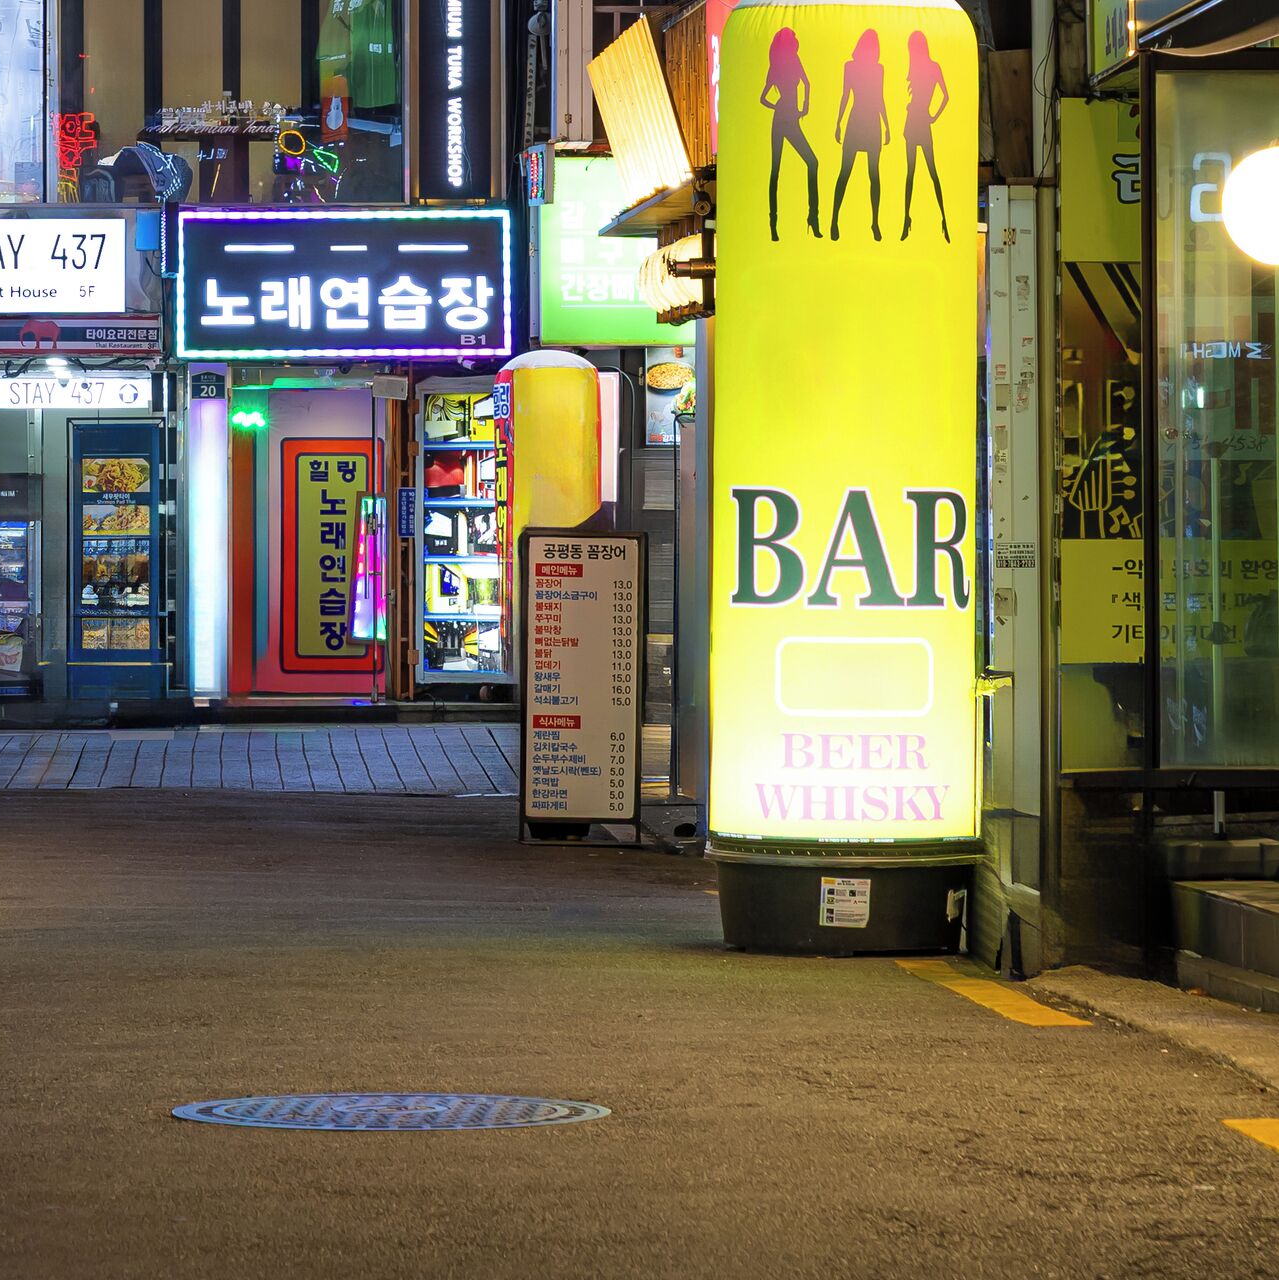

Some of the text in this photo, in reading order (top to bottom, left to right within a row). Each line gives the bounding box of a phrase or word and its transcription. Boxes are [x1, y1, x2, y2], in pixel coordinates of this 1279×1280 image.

[447, 45, 463, 90] TUNA
[447, 96, 463, 188] WORKSHOP
[50, 234, 107, 271] 437
[9, 284, 58, 300] House
[79, 285, 96, 299] 5F
[200, 274, 494, 332] 노래연습장
[85, 328, 158, 340] 타이요리전문점
[460, 333, 488, 346] B1
[9, 381, 105, 405] STAY 437
[200, 385, 217, 398] 20
[543, 543, 626, 561] 공평동 꼼장어
[729, 485, 972, 609] BAR
[319, 488, 347, 651] 노래연습장
[541, 565, 577, 576] 메인메뉴
[535, 579, 633, 589] 꼼장어 13.0
[535, 591, 632, 601] 꼼장어소금구이 13.0
[535, 602, 632, 612] 불돼지 13.0
[612, 615, 632, 624] 13.0
[612, 627, 632, 636] 13.0
[612, 639, 632, 648] 13.0
[612, 650, 632, 659] 13.0
[534, 660, 631, 671] 껍데기 11.0
[534, 672, 631, 683] 왕새우 15.0
[534, 684, 631, 694] 갈매기 16.0
[534, 695, 631, 706] 석쇠불고기 15.0
[539, 717, 576, 727] 식사메뉴
[610, 732, 626, 741] 6.0
[533, 742, 625, 753] 김치칼국수 7.0
[782, 732, 928, 771] BEER
[532, 754, 625, 765] 순두부수제비 7.0
[610, 767, 625, 776] 5.0
[532, 777, 625, 788] 주먹밥 5.0
[532, 789, 624, 800] 한강라면 5.0
[609, 802, 624, 811] 5.0
[755, 782, 953, 824] WHISKY
